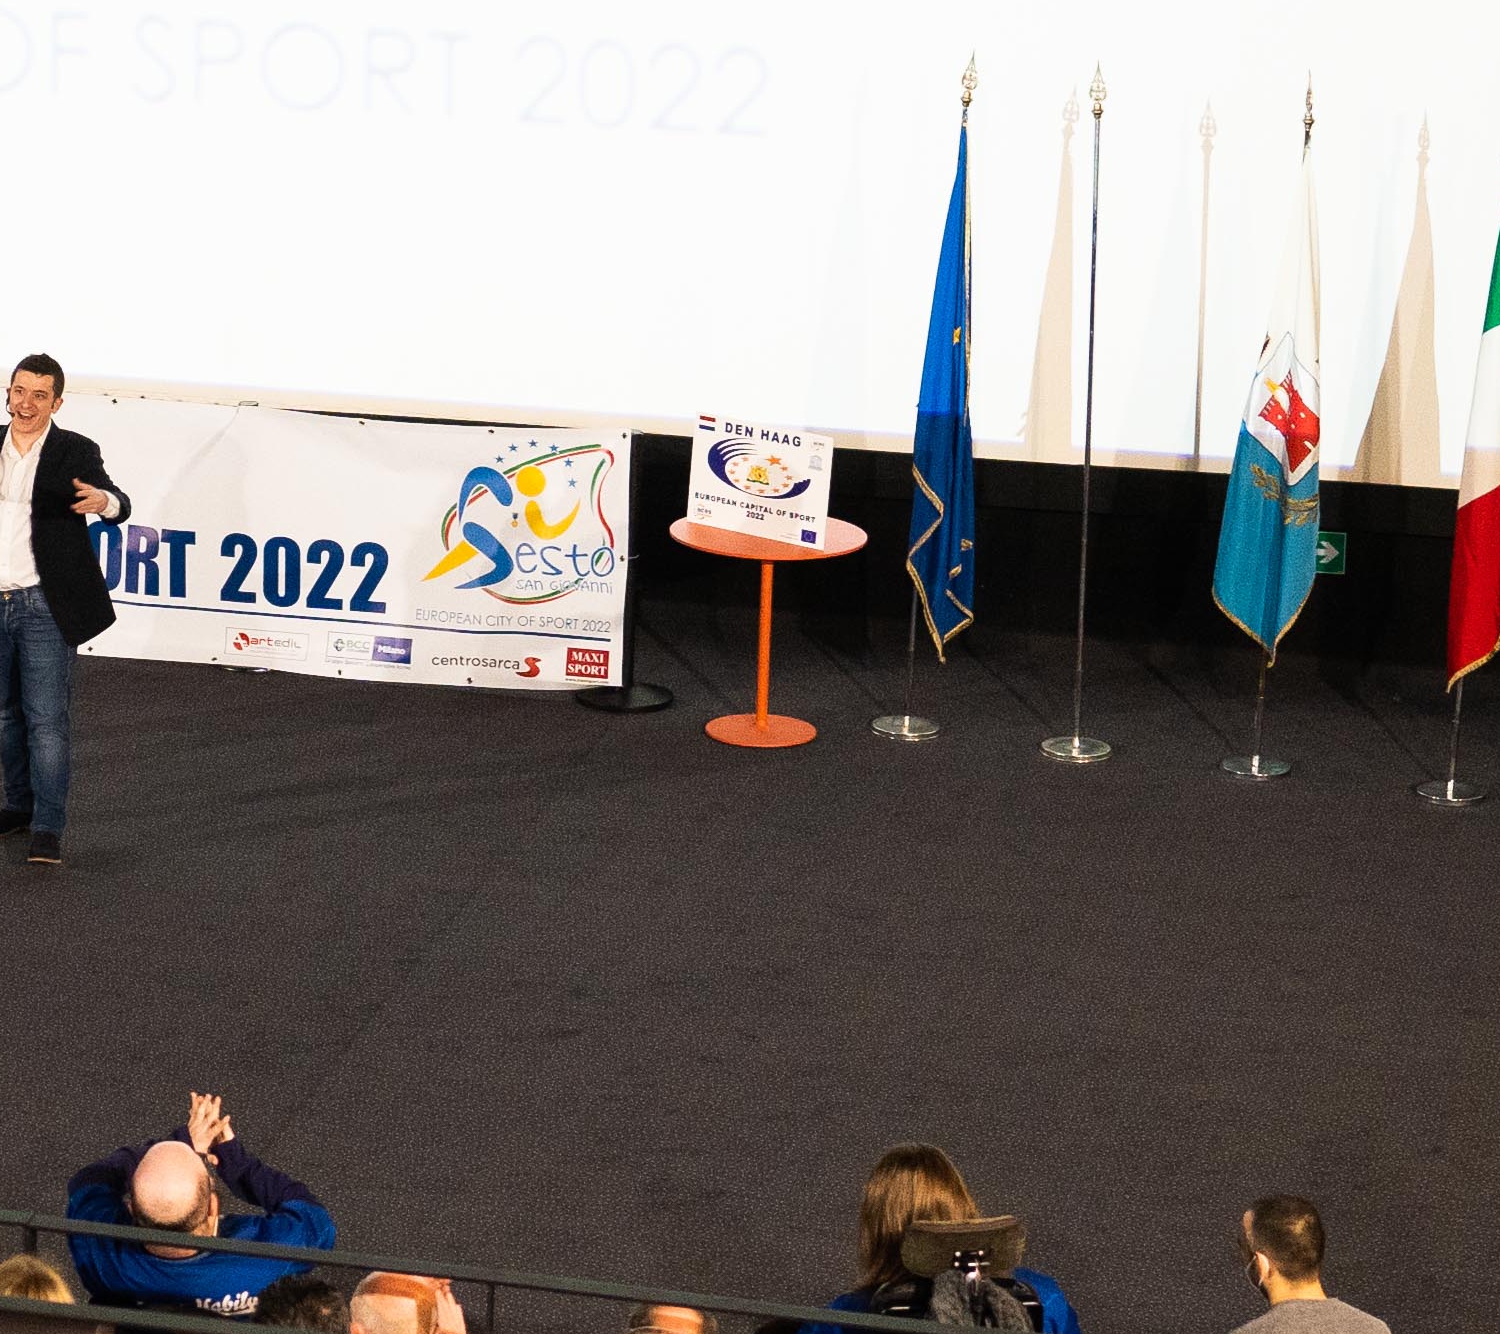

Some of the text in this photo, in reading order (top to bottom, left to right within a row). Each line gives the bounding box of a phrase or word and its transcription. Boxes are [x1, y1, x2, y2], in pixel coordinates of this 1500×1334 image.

[131, 10, 470, 119] SPORT
[513, 32, 774, 136] 2022
[725, 422, 802, 447] DEN HAAG
[695, 492, 816, 523] EUROPEAN CAPITAL OF SPORT
[746, 510, 765, 521] 2022
[219, 532, 390, 614] 2022
[415, 608, 612, 634] EUROPEAN CITY OF SPORT 2022
[346, 639, 370, 650] BCC
[431, 654, 520, 671] centrosarca
[571, 651, 604, 664] MAXI
[567, 663, 608, 676] SPORT
